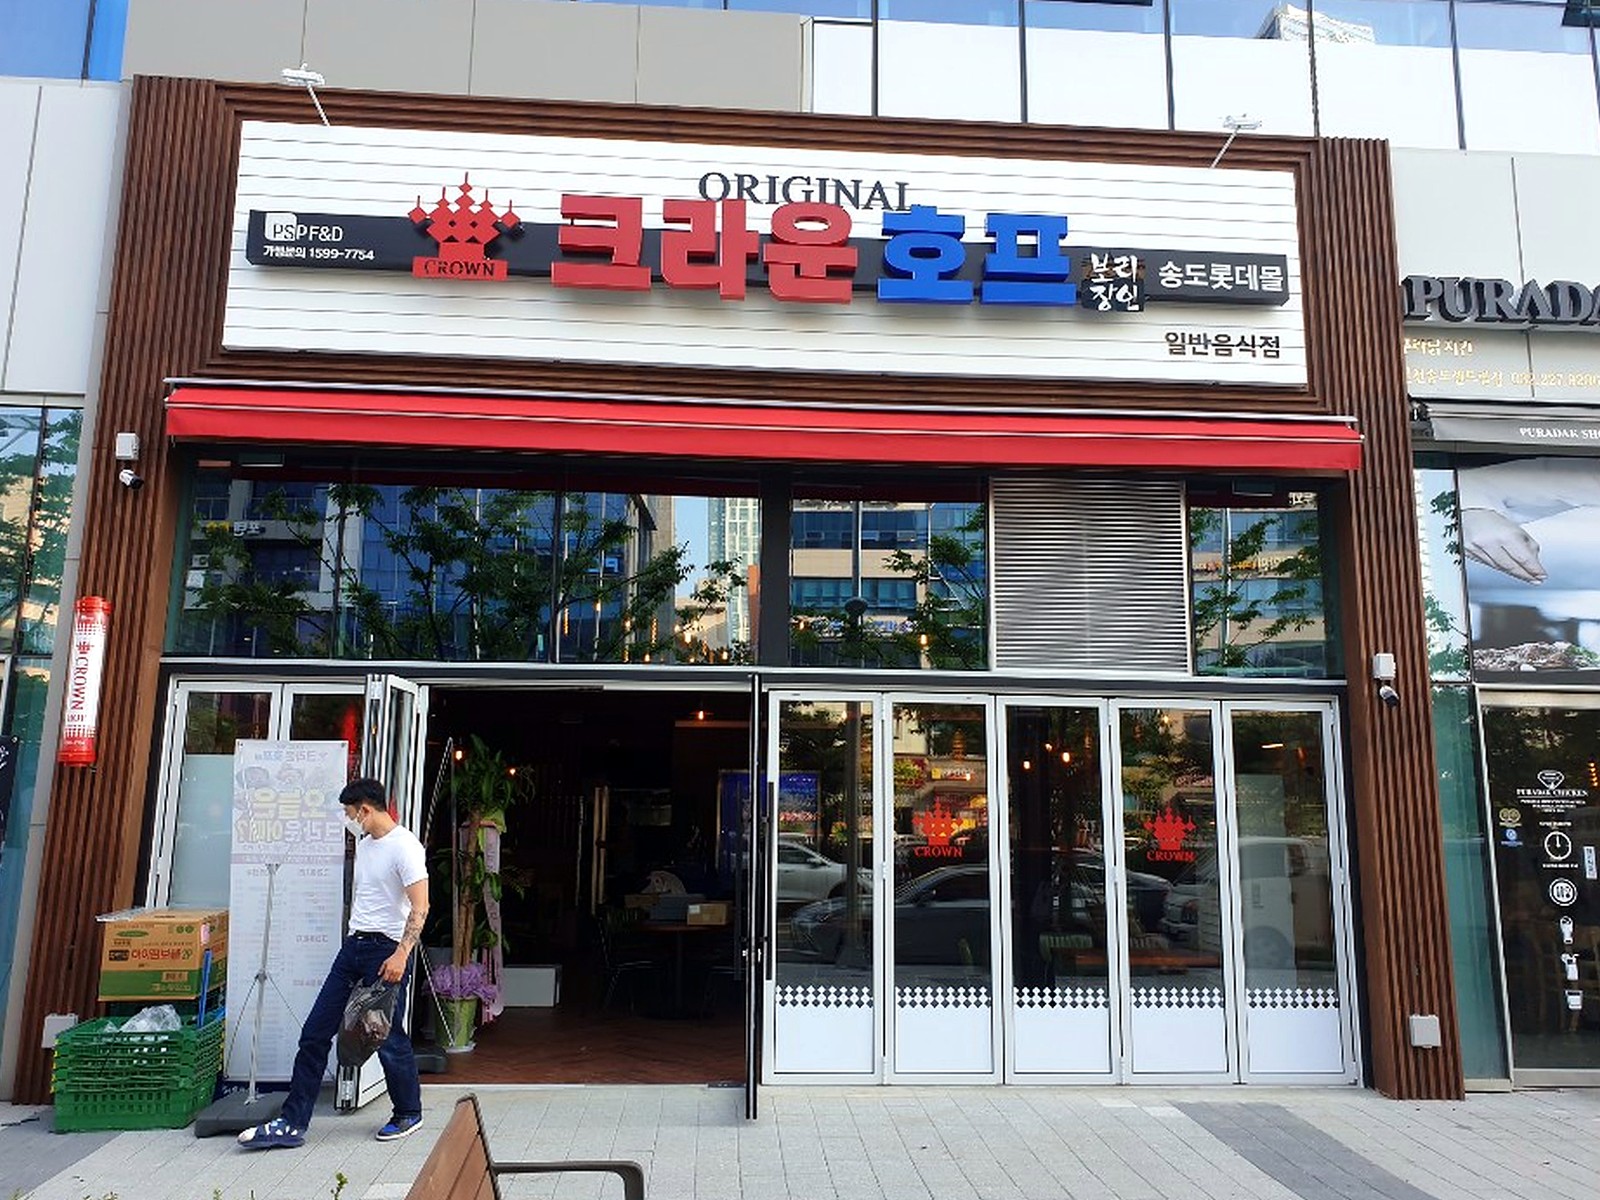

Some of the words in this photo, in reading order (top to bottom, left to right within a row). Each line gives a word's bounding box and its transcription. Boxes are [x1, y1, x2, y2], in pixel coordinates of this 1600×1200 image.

[308, 246, 375, 261] 1599-7754
[424, 259, 495, 277] CROWN
[1089, 252, 1139, 283] 보리
[1157, 260, 1284, 292] 송도롯데몰
[1089, 283, 1140, 312] 장인
[1164, 331, 1281, 359] 일반음식점
[1581, 429, 1600, 440] SH
[70, 656, 89, 711] CROWN
[914, 846, 963, 858] CROWN
[1147, 850, 1196, 862] CROWN
